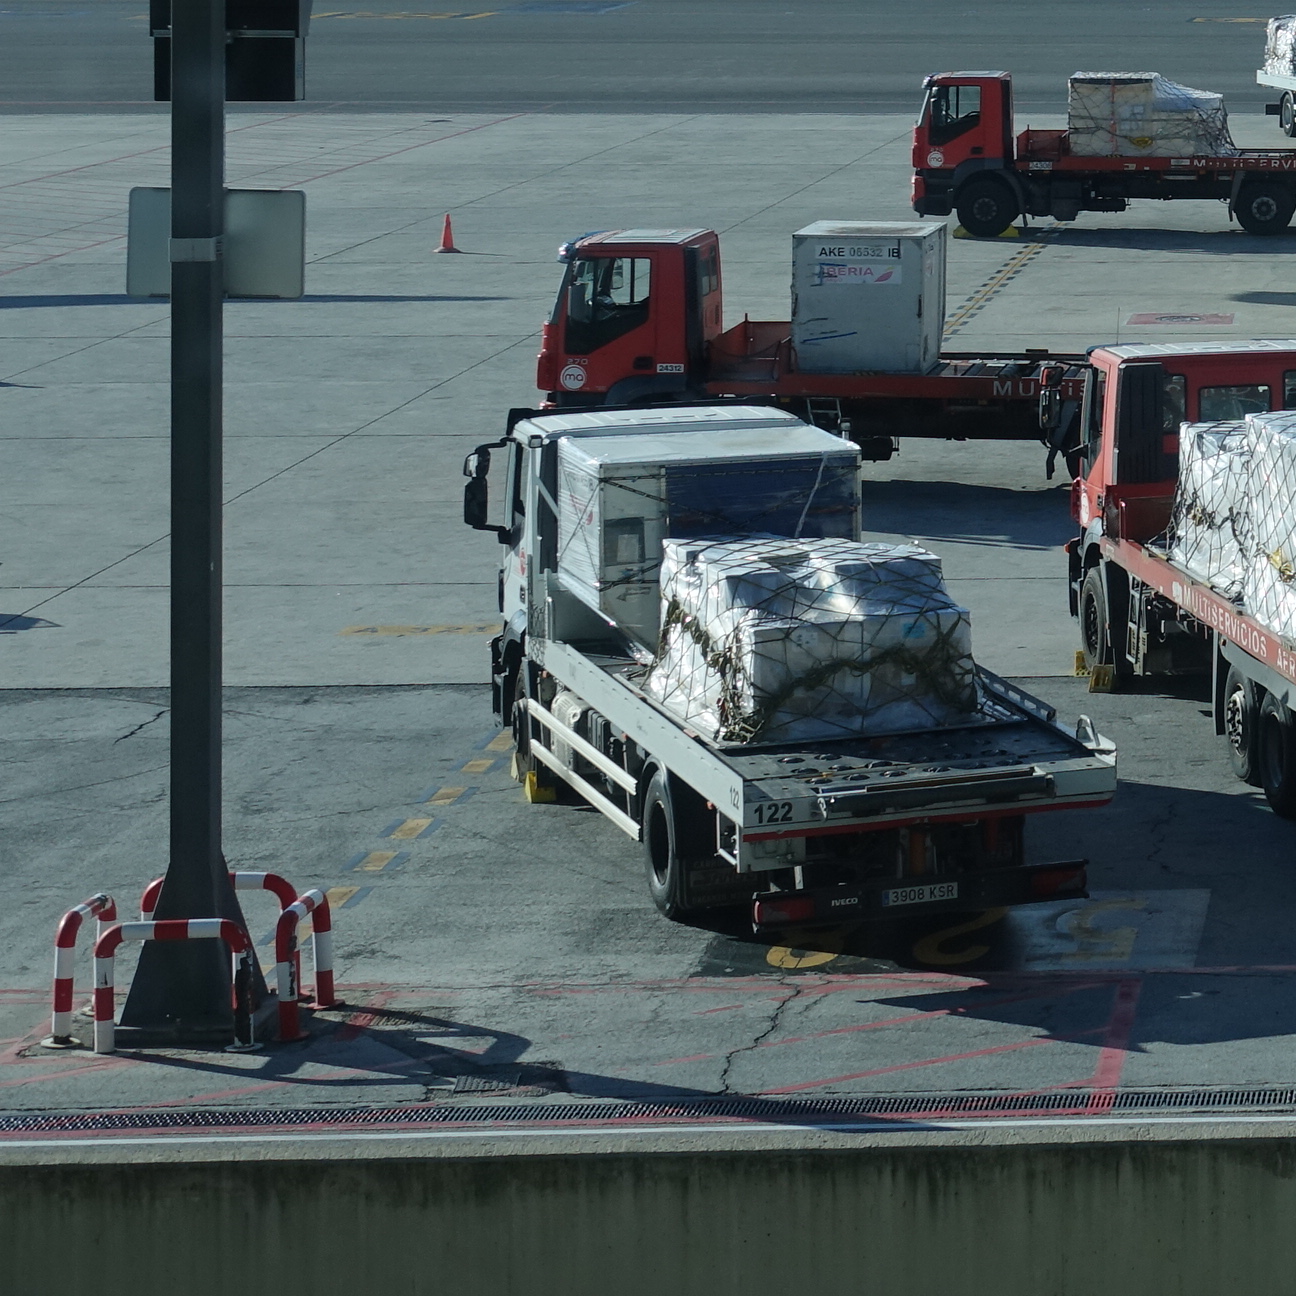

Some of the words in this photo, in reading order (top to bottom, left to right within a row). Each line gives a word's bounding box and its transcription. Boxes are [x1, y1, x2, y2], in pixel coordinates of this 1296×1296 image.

[818, 247, 845, 257] AKE
[888, 248, 900, 258] IB
[658, 364, 682, 372] 24312
[564, 373, 584, 382] ma
[730, 784, 740, 810] 122
[753, 802, 793, 824] 122
[891, 887, 925, 903] 3908
[930, 884, 955, 899] KSR
[831, 897, 858, 907] IVECO
